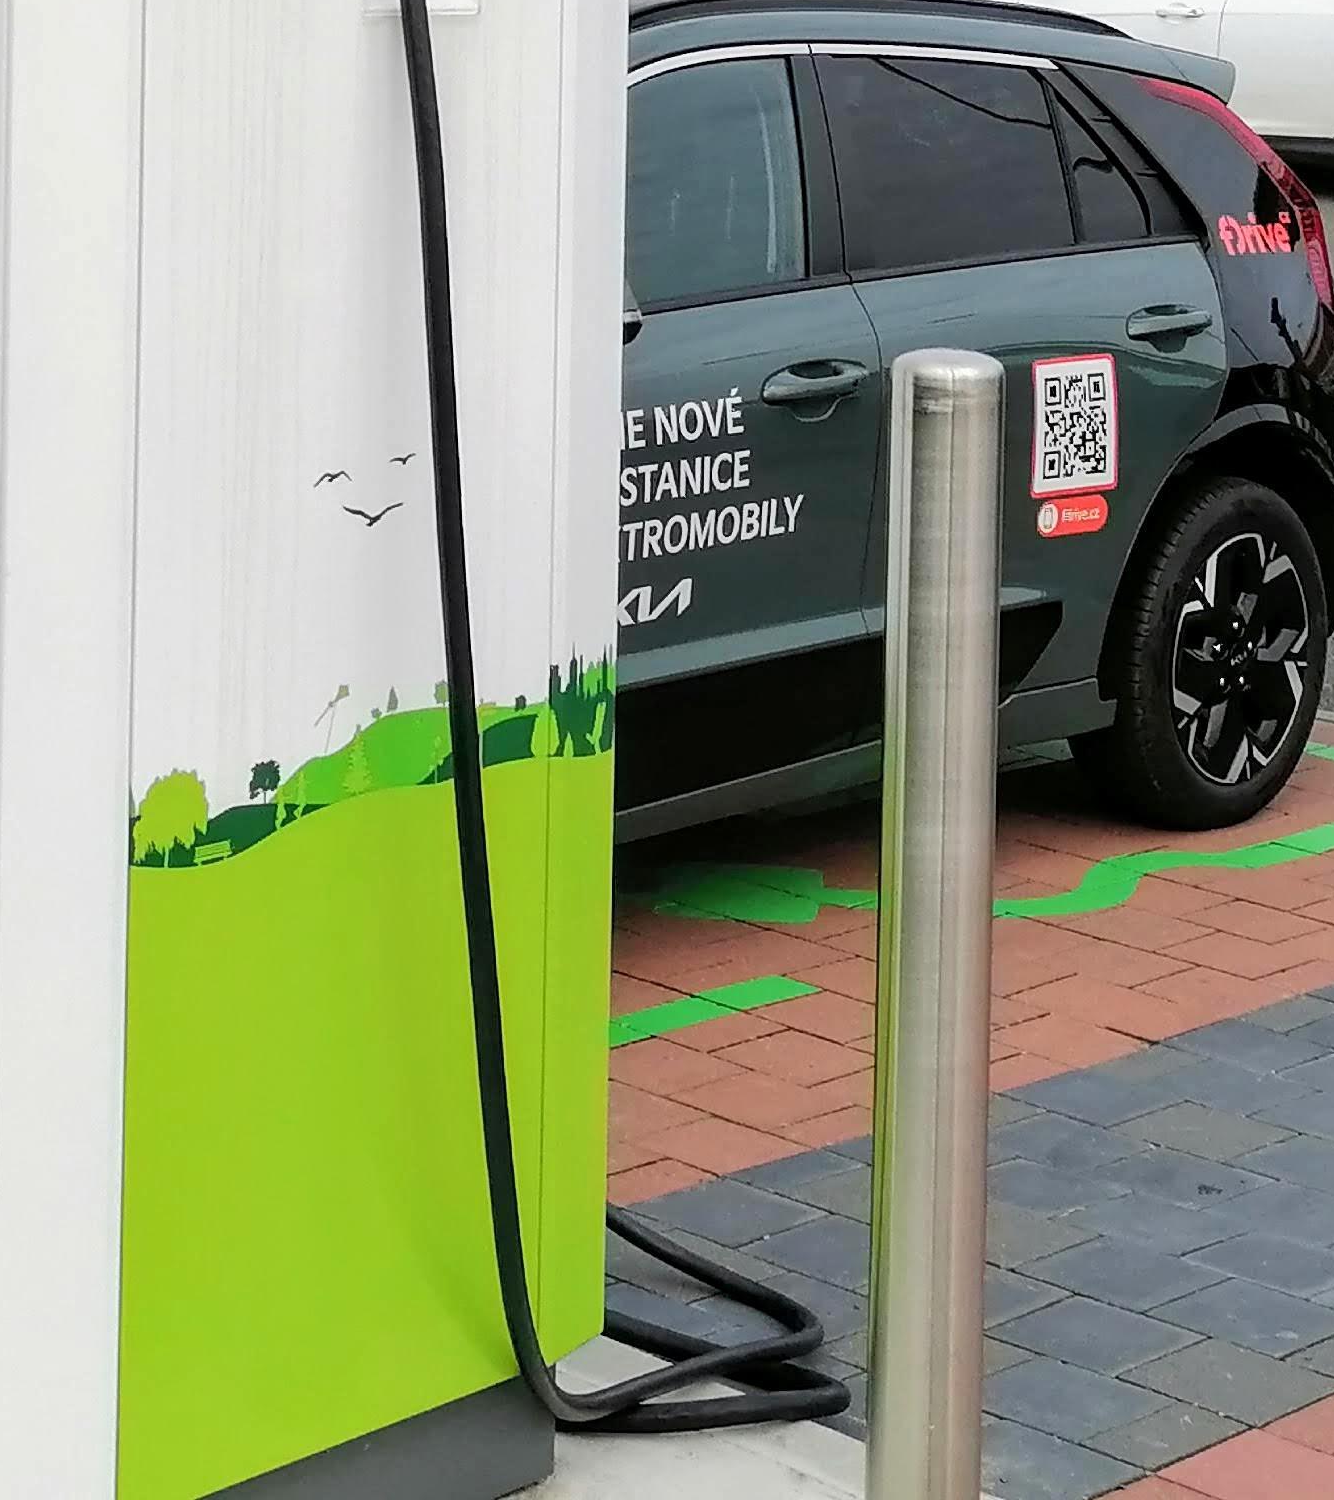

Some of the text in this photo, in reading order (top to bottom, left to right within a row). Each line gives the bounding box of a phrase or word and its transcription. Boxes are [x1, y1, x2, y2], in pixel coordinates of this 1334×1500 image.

[620, 386, 745, 450] E NOVÉ
[620, 449, 751, 507] STANICE
[618, 493, 805, 564] TROMOBILY
